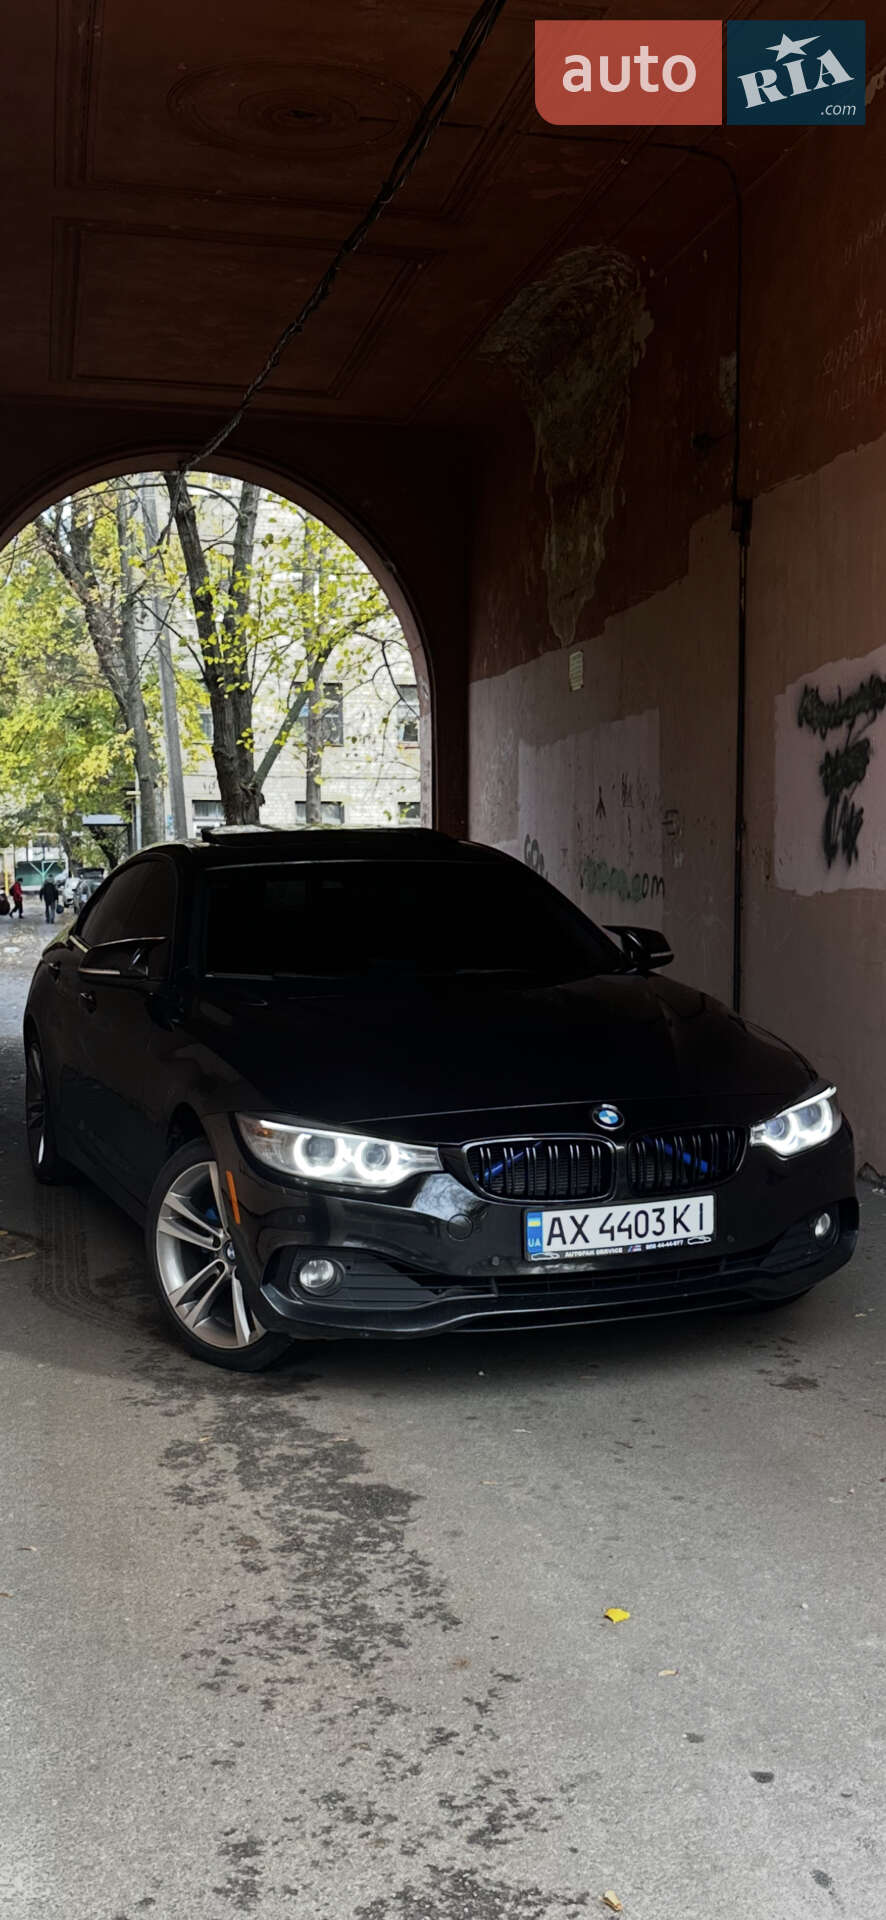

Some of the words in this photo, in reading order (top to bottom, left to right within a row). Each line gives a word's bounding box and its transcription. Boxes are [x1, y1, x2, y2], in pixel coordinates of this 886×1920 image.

[546, 1214, 591, 1246] AX
[599, 1207, 665, 1242] 4403
[673, 1202, 704, 1235] KI
[527, 1238, 542, 1248] UA
